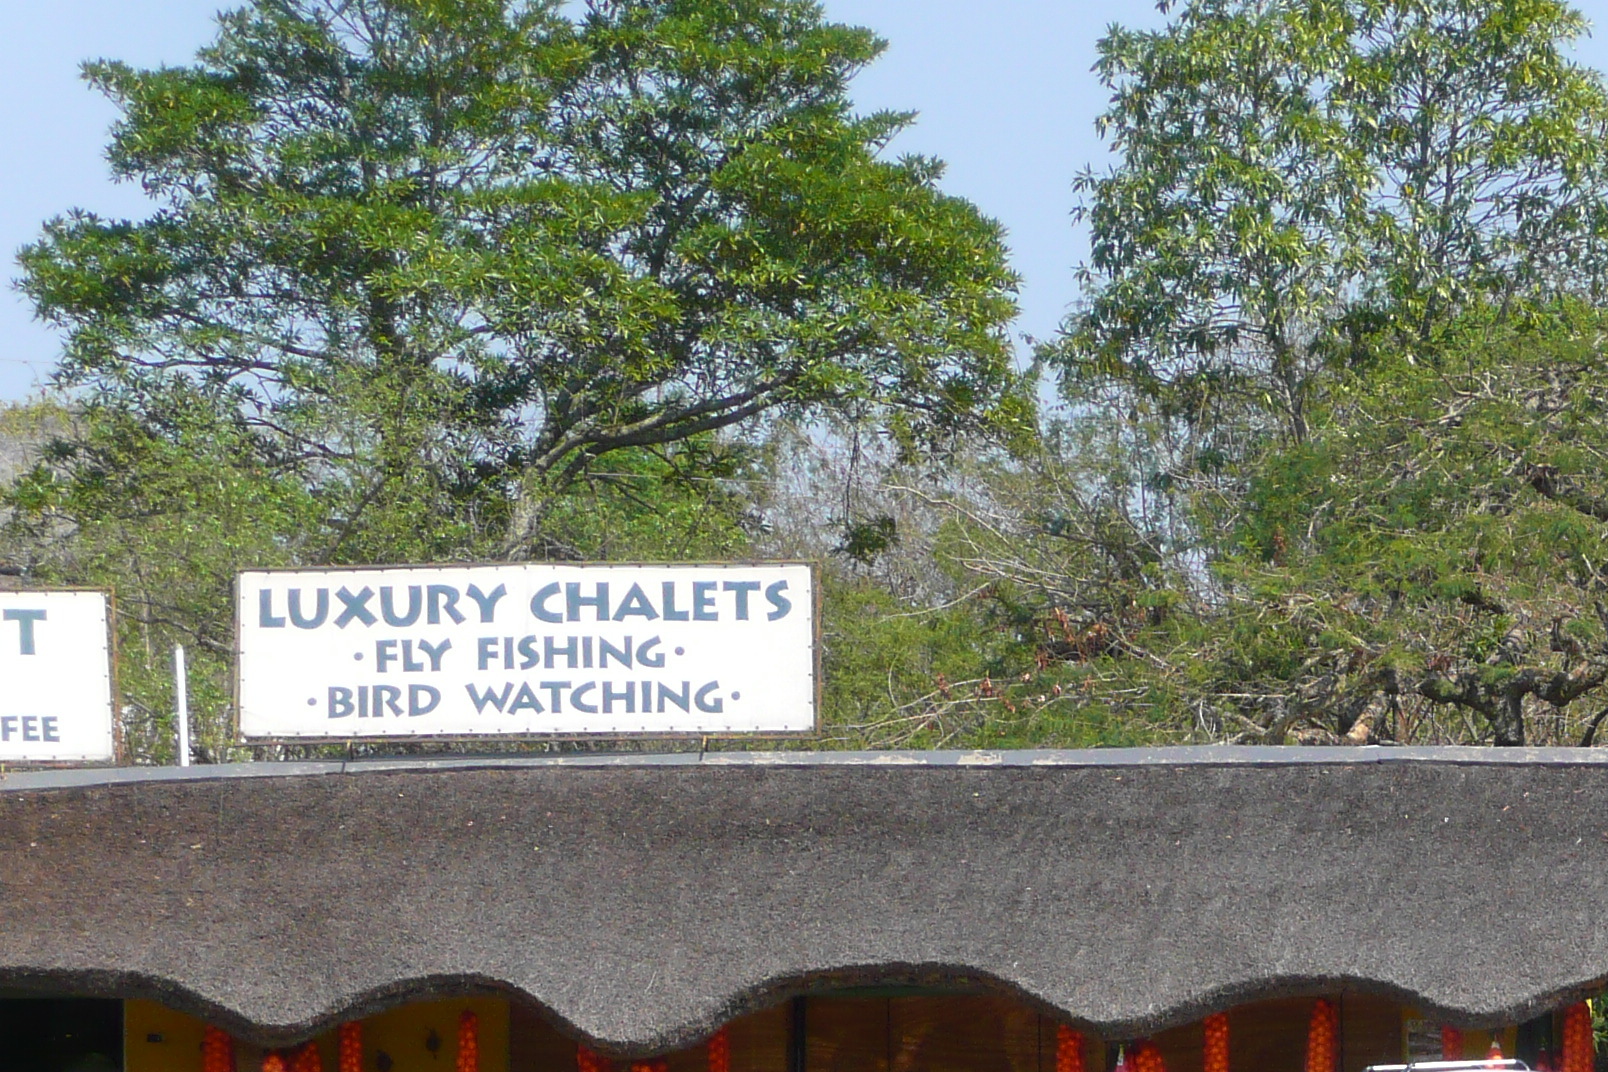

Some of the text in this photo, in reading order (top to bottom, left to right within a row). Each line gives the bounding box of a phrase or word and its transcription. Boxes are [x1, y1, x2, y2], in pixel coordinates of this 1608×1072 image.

[259, 580, 792, 630] LUXURY CHALETS
[376, 636, 665, 673] FLY FISHING
[328, 681, 724, 719] BIRD WATCHING
